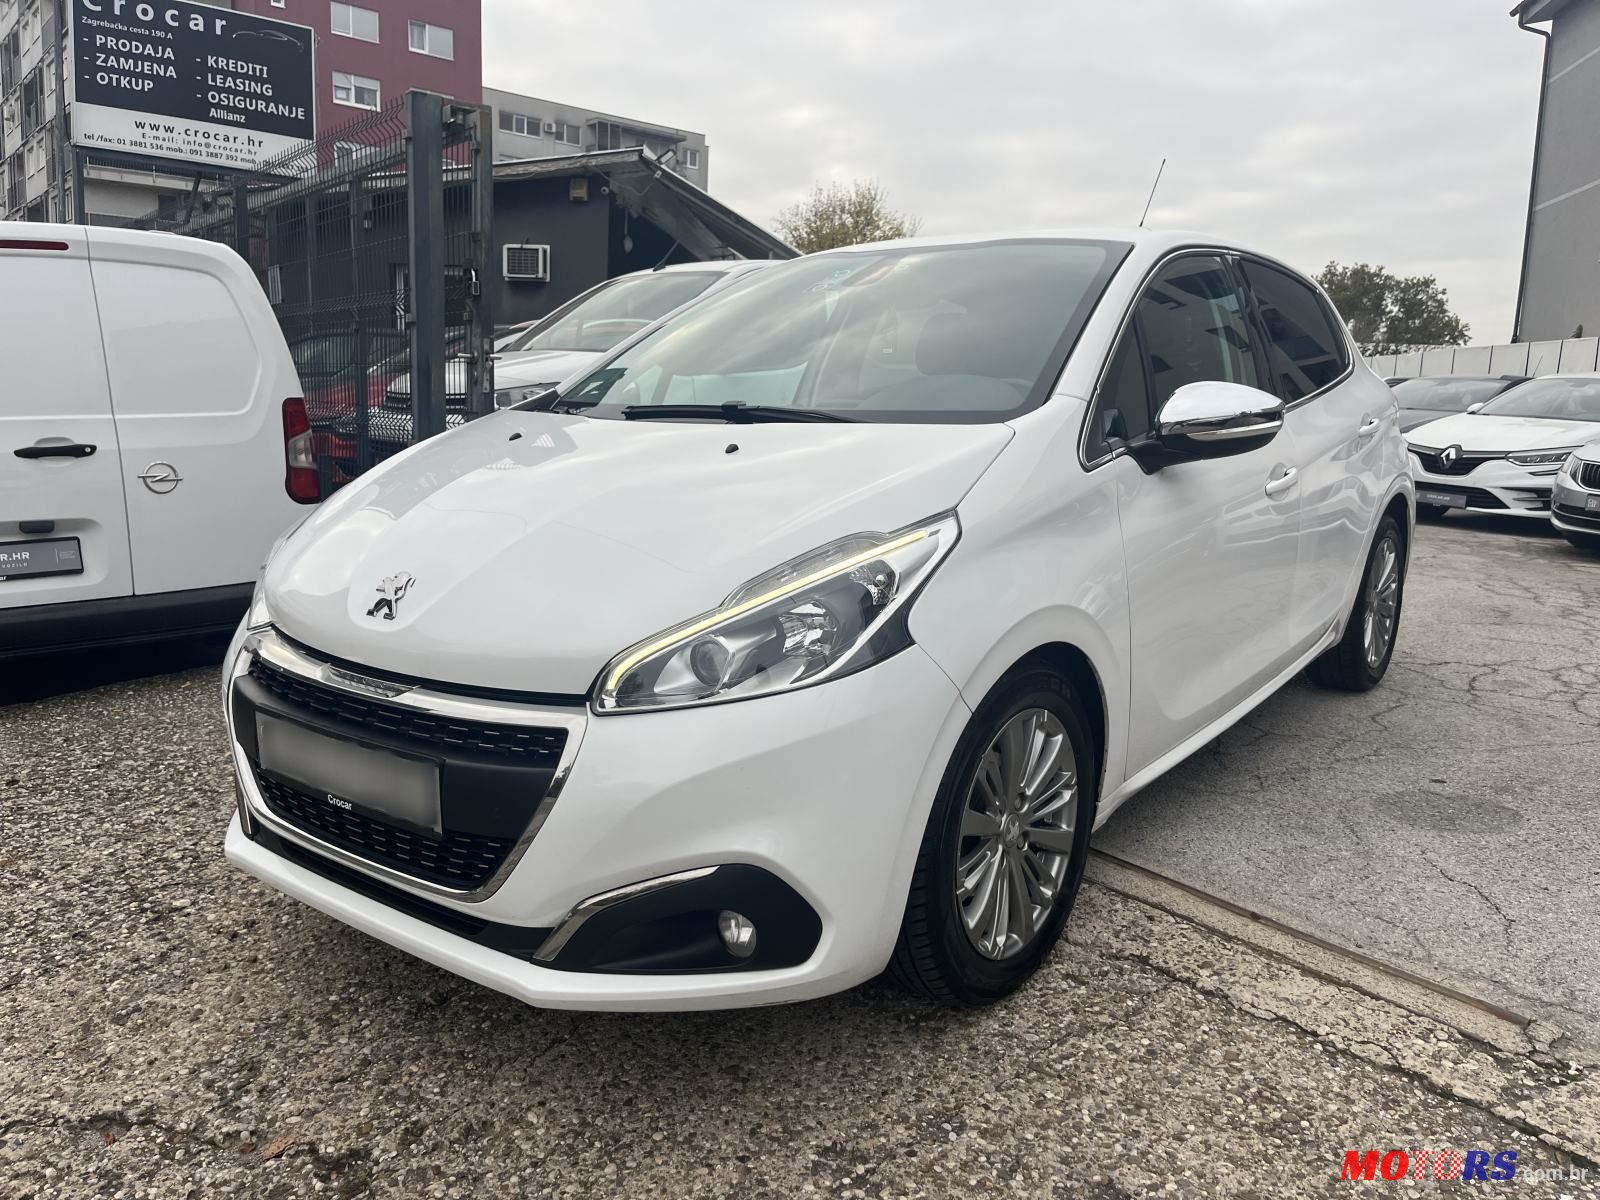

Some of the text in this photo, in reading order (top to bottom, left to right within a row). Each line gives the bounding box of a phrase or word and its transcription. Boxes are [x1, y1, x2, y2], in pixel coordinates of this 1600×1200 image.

[129, 25, 149, 35] cesta
[151, 29, 165, 38] 190
[96, 34, 175, 60] PRODAJA
[96, 53, 177, 78] ZAMJENA
[207, 55, 268, 78] KREDITI
[96, 72, 154, 92] OTKUP
[207, 73, 273, 96] LEASING
[207, 91, 305, 120] OSIGURANJE
[209, 107, 246, 123] Allianz
[134, 120, 264, 148] www.crocar.hr
[142, 132, 257, 156] E-mail: info@crocar.hr
[189, 148, 203, 156] 091
[225, 154, 238, 162] 392
[327, 794, 352, 811] Crocar
